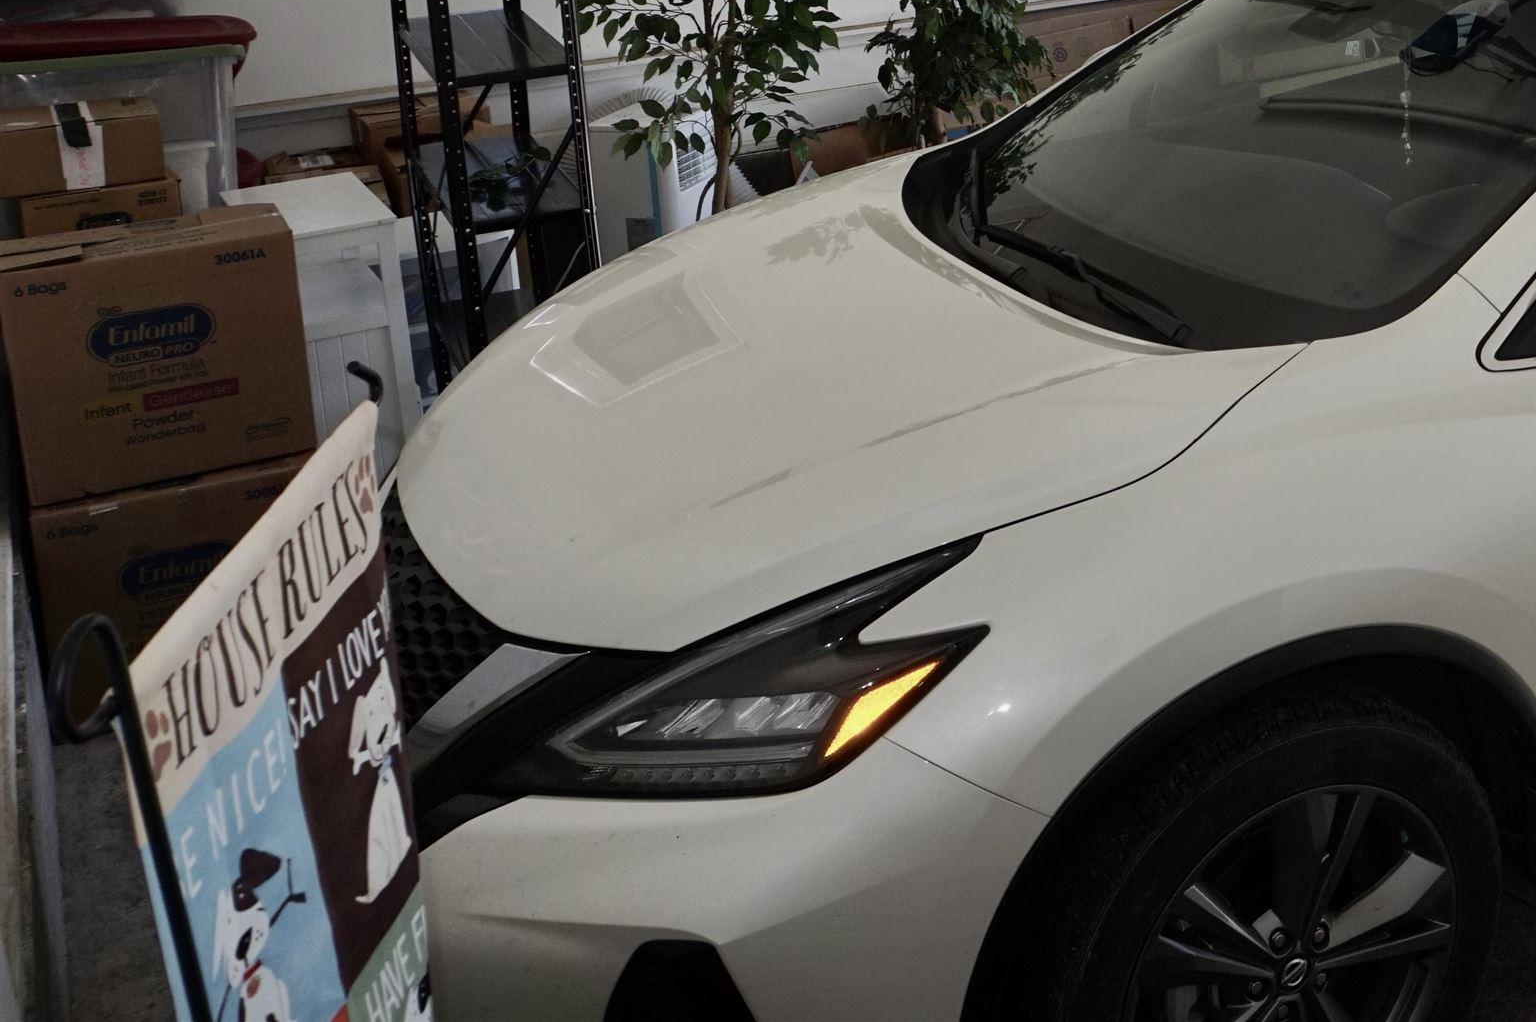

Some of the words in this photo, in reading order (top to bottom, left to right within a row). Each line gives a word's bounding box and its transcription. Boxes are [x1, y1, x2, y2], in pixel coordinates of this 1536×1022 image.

[214, 247, 267, 266] 30061A
[14, 286, 24, 298] 6
[28, 279, 68, 297] Bags
[107, 314, 196, 347] Enfamil
[114, 346, 161, 364] NEURO
[165, 342, 195, 357] PRO
[108, 365, 147, 384] Infant
[150, 357, 206, 378] Formula
[147, 382, 234, 409] Gentlease
[84, 402, 133, 420] Infant
[132, 409, 196, 431] Powder
[162, 568, 275, 770] HOUSE
[277, 462, 370, 640] RULES
[287, 670, 324, 751] SAY
[326, 659, 339, 704] I
[337, 608, 385, 690] LOVE
[205, 718, 288, 860] NICE!
[365, 932, 415, 1021] HAVE
